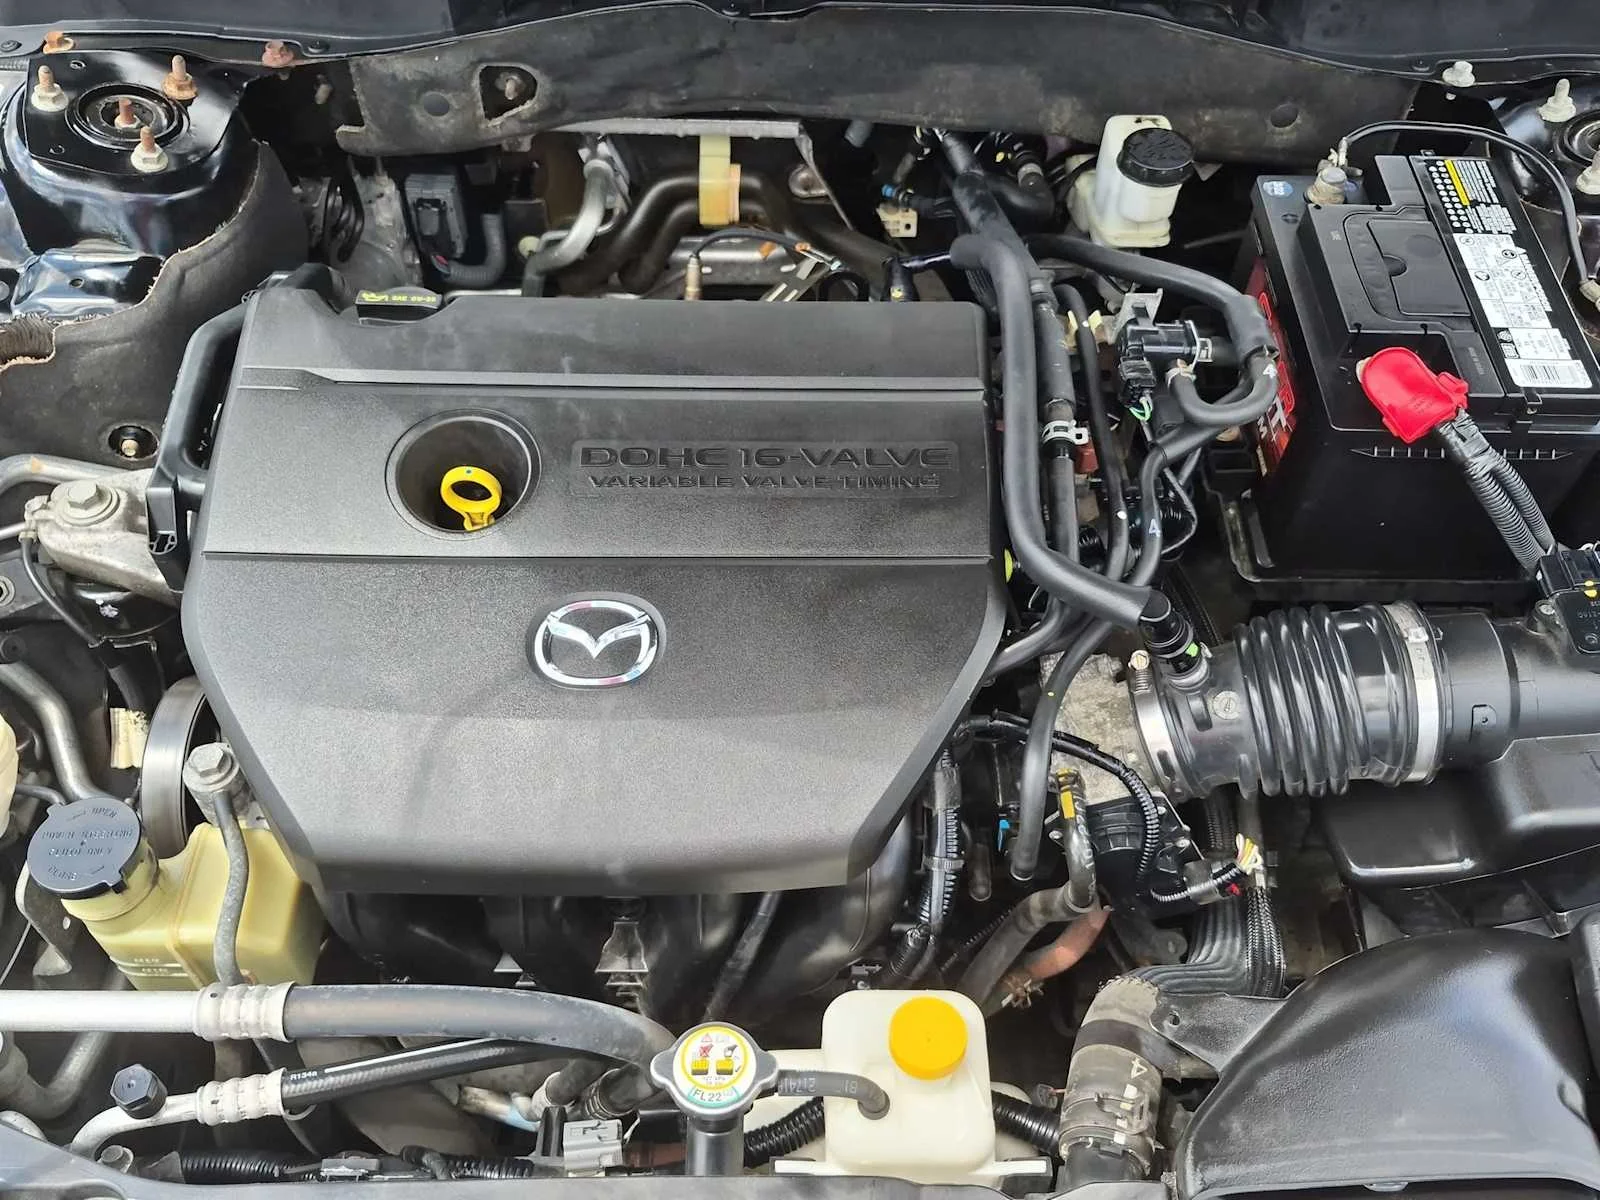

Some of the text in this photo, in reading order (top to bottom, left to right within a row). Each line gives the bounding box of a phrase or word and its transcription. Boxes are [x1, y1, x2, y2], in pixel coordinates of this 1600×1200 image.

[580, 446, 951, 468] DOHC 16-VALVE
[588, 473, 942, 489] VARIABLE VALVE TIMING
[692, 1088, 723, 1102] FL22
